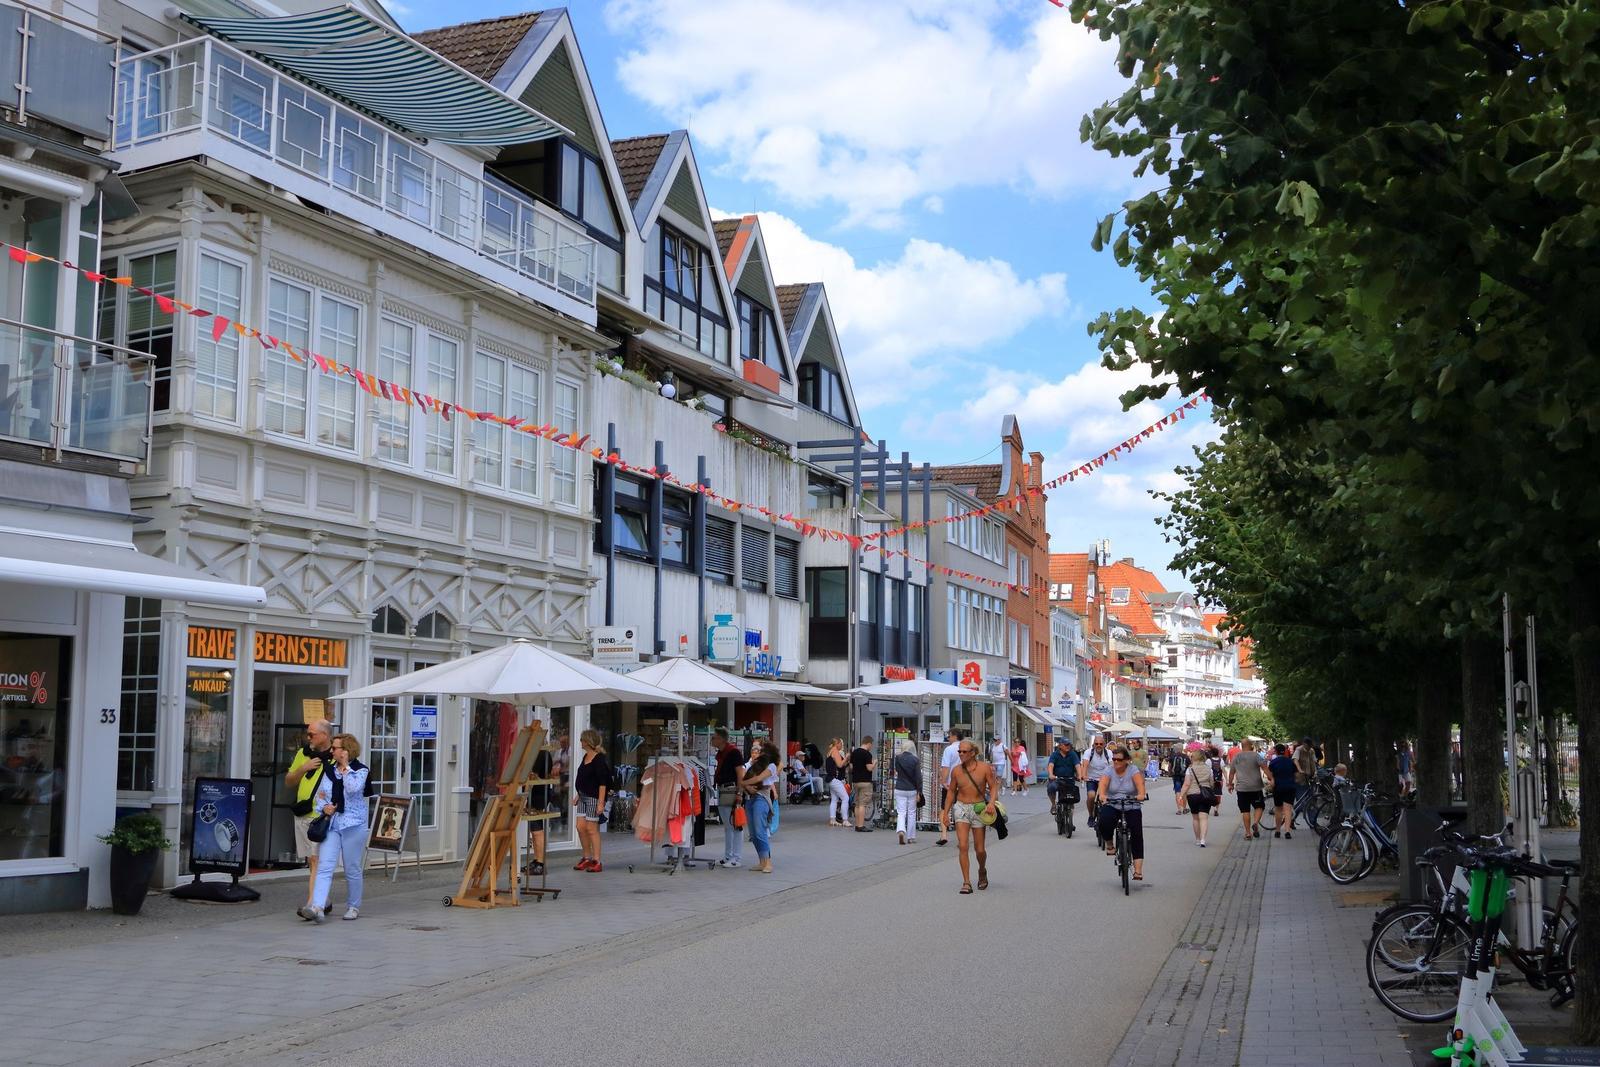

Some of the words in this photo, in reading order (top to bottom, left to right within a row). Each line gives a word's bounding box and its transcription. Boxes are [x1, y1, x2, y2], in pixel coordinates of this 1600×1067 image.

[188, 626, 235, 660] TRAVE
[255, 631, 347, 668] BERNSTEIN
[193, 679, 227, 692] ANKAUF
[100, 708, 116, 724] 33
[1471, 938, 1483, 961] Lime
